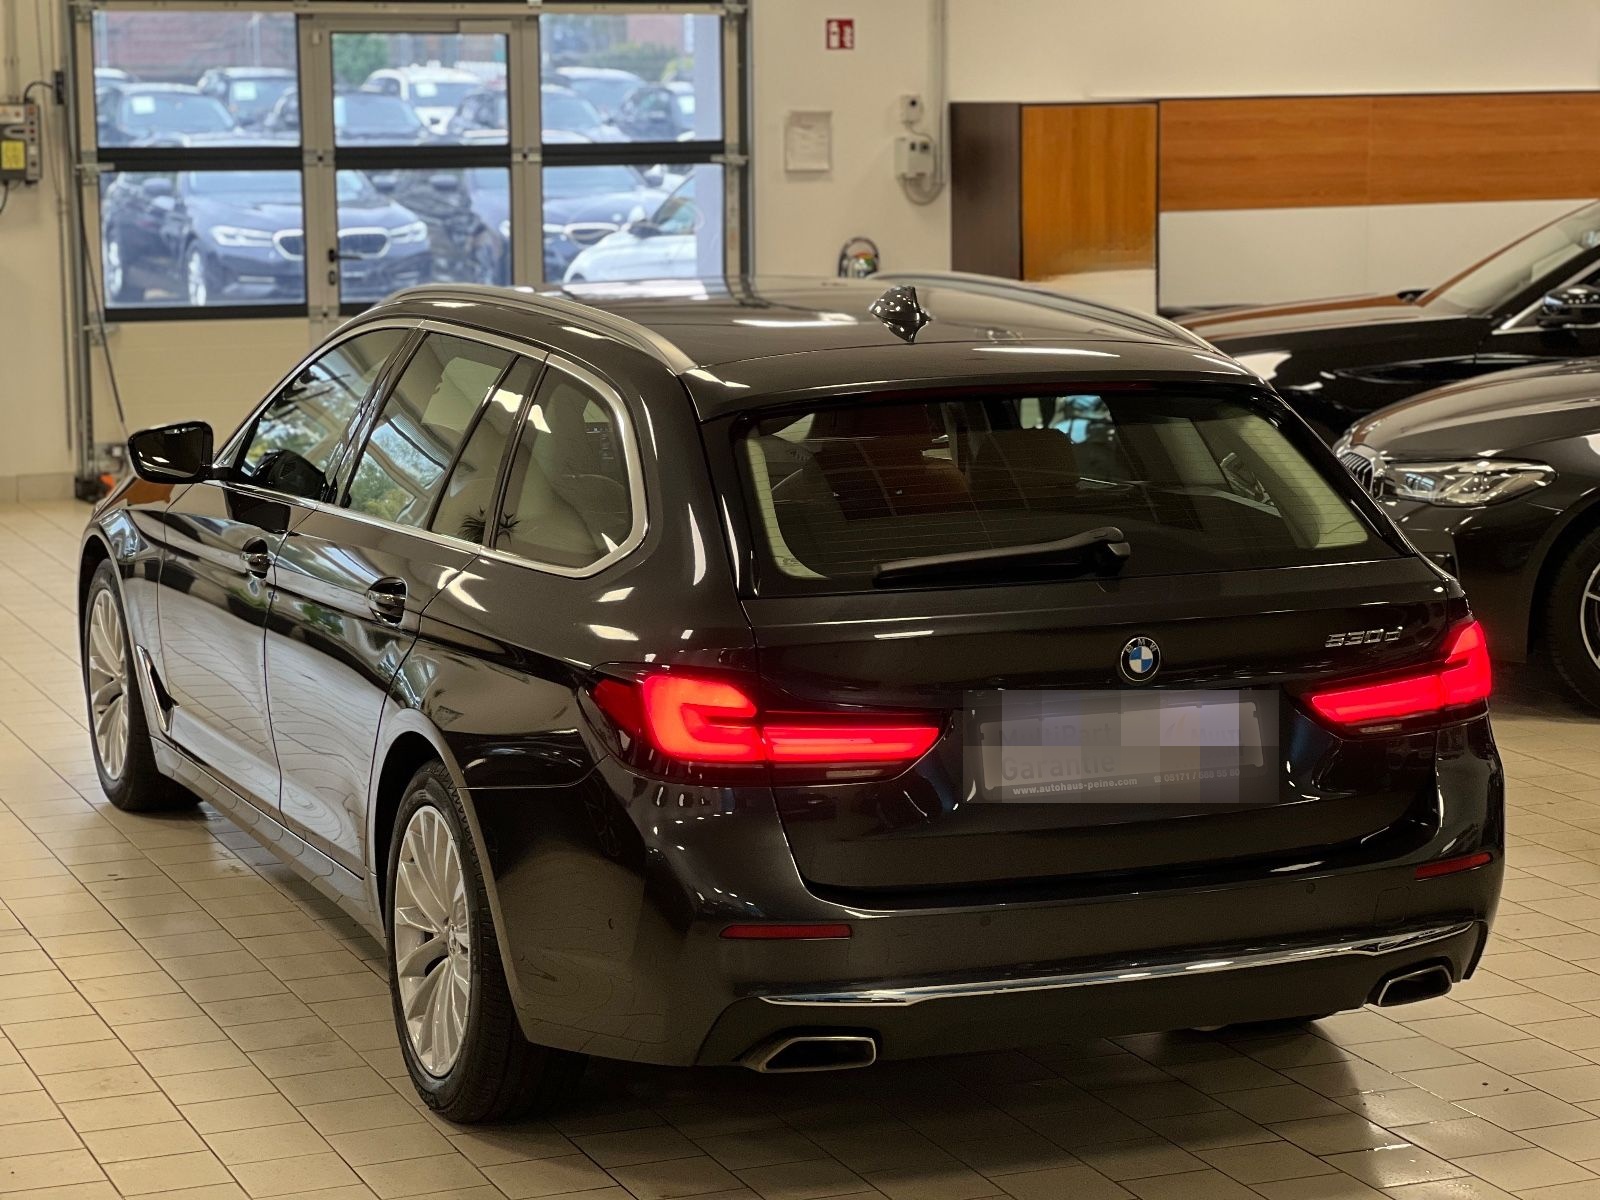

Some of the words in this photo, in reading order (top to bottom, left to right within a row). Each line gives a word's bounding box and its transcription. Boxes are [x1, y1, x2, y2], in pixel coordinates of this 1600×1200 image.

[1325, 626, 1403, 648] 530d
[1001, 753, 1115, 781] Garantie
[1012, 778, 1138, 795] www.autohaus-peine.com
